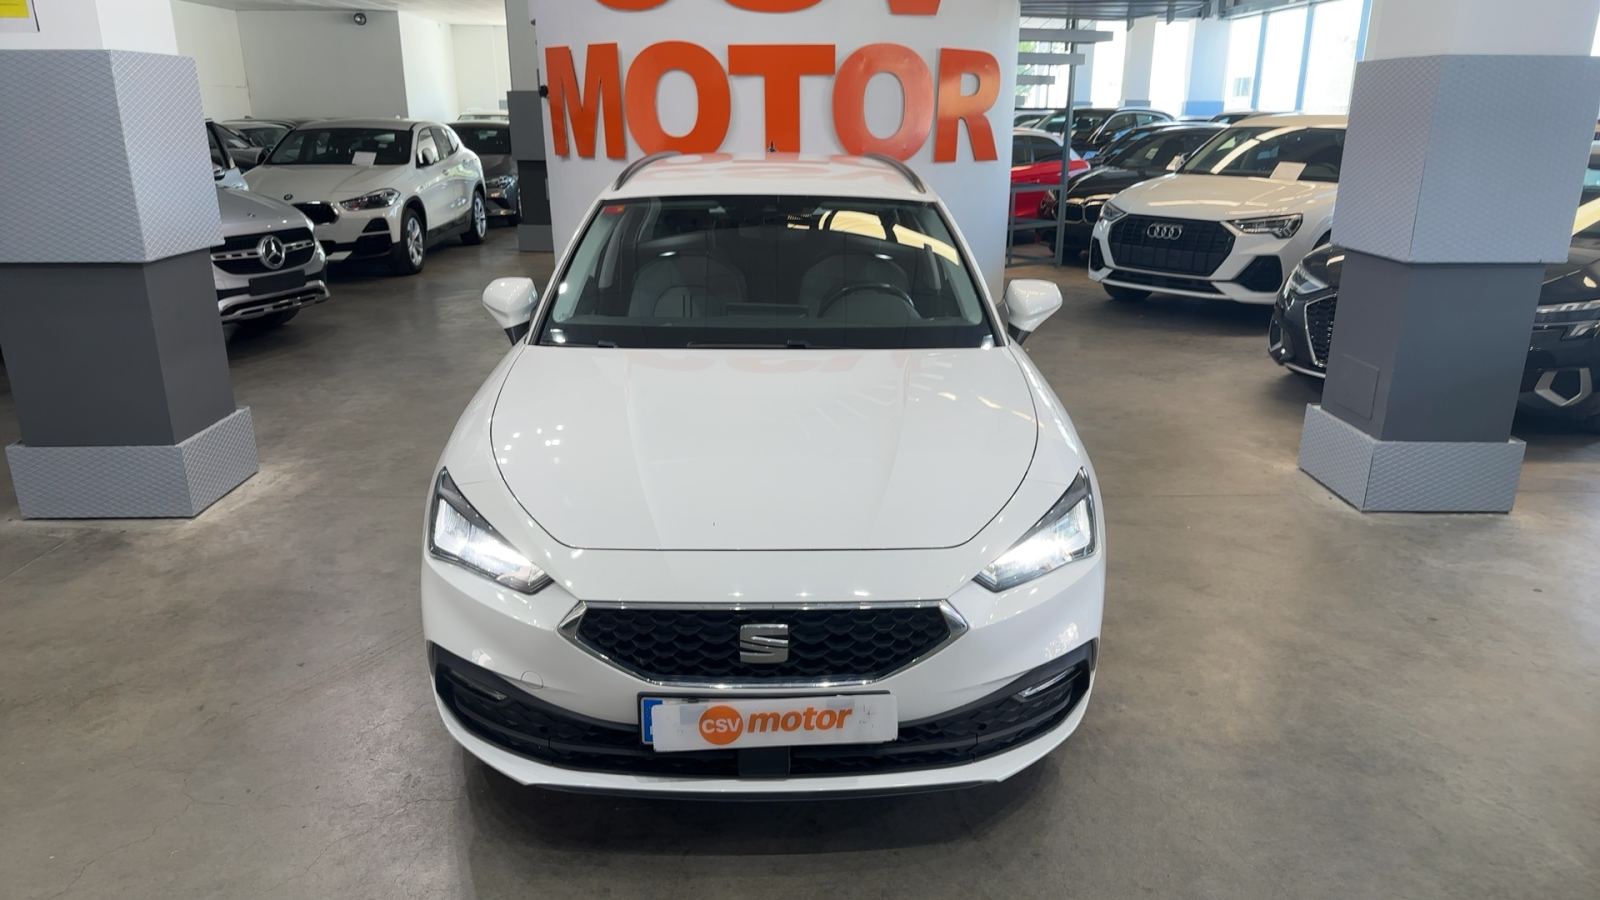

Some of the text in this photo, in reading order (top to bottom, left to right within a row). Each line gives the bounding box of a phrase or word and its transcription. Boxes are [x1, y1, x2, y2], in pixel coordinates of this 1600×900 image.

[545, 41, 1001, 162] MOTOR
[701, 706, 852, 734] CSV motor
